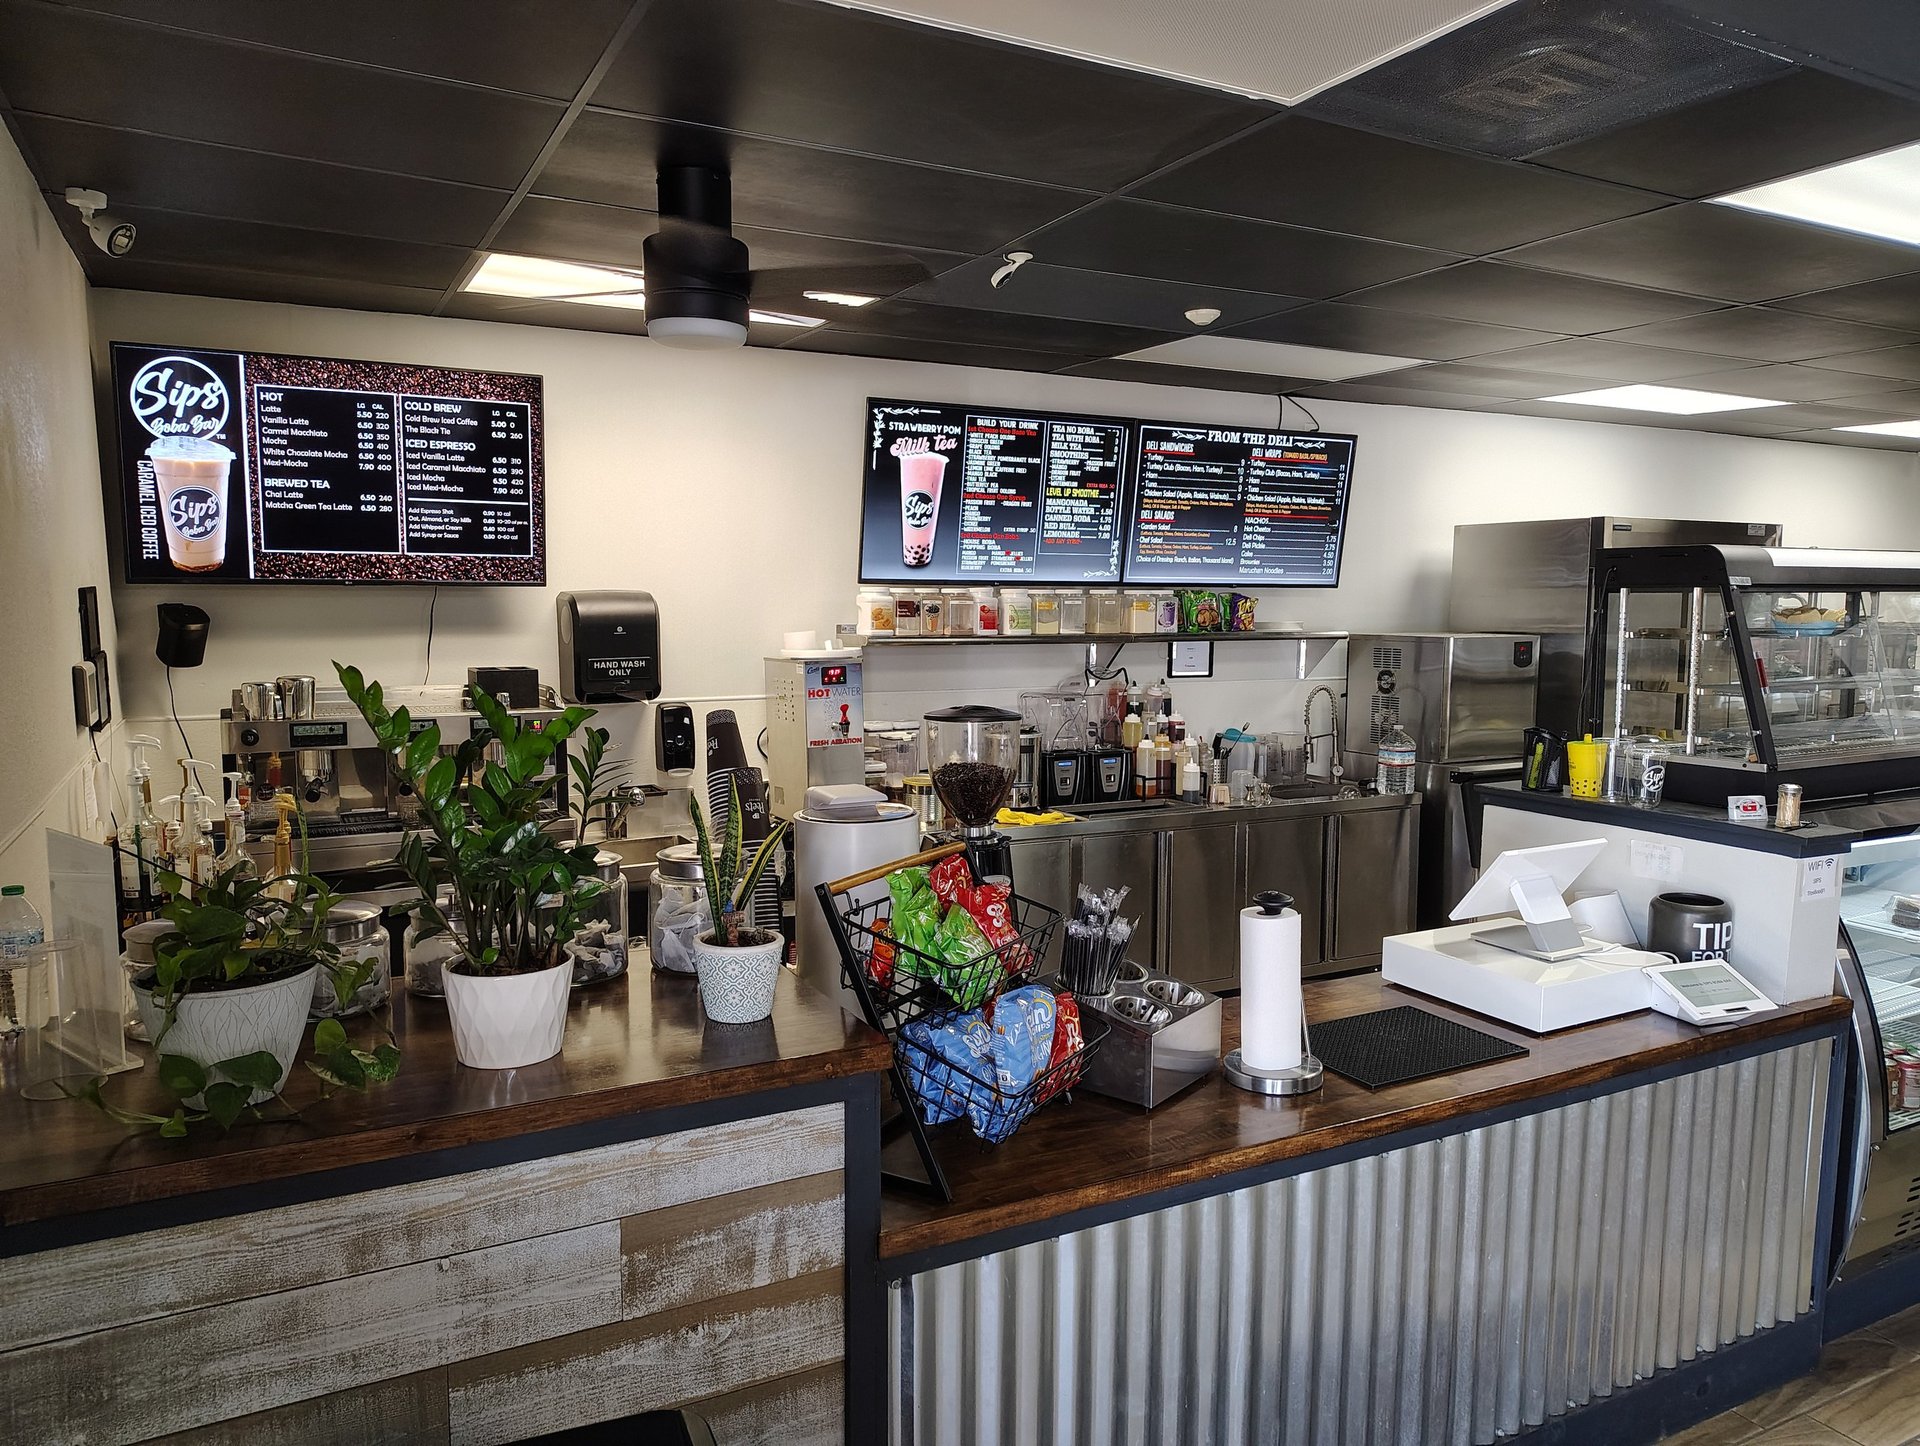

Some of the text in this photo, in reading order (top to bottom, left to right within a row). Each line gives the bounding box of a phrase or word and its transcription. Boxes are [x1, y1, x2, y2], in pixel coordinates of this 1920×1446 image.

[135, 367, 223, 418] Sips
[260, 391, 283, 401] HOT
[404, 401, 462, 413] COLD BREW
[151, 414, 220, 434] Boba Bar
[261, 416, 288, 424] Vanilla
[289, 418, 310, 426] Latte
[405, 414, 420, 422] Cold
[422, 415, 440, 424] Brew
[441, 416, 455, 424] Iced
[456, 418, 478, 426] Coffee
[977, 418, 1038, 430] BUILD YOUR DRINK
[262, 426, 290, 436] Carmel
[290, 428, 328, 438] Macchiato
[405, 425, 418, 433] The
[420, 426, 440, 435] Black
[440, 427, 450, 435] Tie
[888, 422, 962, 436] STRAWBERRY POM
[1066, 426, 1076, 434] NO
[1077, 426, 1094, 435] BOBA
[262, 436, 288, 446] Mocha
[1066, 434, 1084, 442] WITH
[1084, 436, 1100, 444] BOBA
[1208, 430, 1294, 448] FROM THE DELI
[405, 439, 476, 451] ICED ESPRESSO
[890, 434, 958, 457] Milk tea
[1146, 440, 1194, 452] DELI SANDWICHES
[263, 447, 286, 456] White
[286, 448, 322, 458] Chocolate
[324, 451, 348, 459] Mocha
[406, 451, 420, 460] Iced
[422, 452, 446, 460] Vanilla
[446, 454, 465, 462] Latte
[1050, 450, 1089, 460] SMOOTHIES
[1148, 453, 1164, 462] Turkey
[1252, 448, 1282, 458] DELI WRAPS
[263, 458, 308, 468] Mexi-Mocha
[406, 462, 420, 470] Iced
[422, 463, 451, 472] Caramel
[452, 464, 486, 474] Macchiato
[264, 478, 330, 489] BREWED TEA
[422, 474, 446, 482] Mocha
[407, 482, 422, 490] Iced
[422, 484, 464, 492] Mexi-Mocha
[265, 490, 282, 498] Chai
[284, 491, 304, 499] Latte
[1046, 488, 1062, 496] LEVEL
[1064, 488, 1072, 497] UP
[1072, 488, 1100, 498] SMOOTHIE
[265, 500, 294, 509] Matcha
[294, 502, 316, 510] Green
[318, 502, 332, 510] Tea
[333, 503, 353, 511] Latte
[905, 494, 934, 516] Sips
[1046, 498, 1088, 506] MANGONADA
[137, 460, 160, 560] CARAMEL ICED COFFEE
[170, 495, 218, 526] Sips
[1140, 510, 1174, 520] DELI SALADS
[1044, 514, 1072, 522] CANNED
[1043, 530, 1080, 538] LEMONADE
[594, 660, 646, 670] HAND WASH
[608, 668, 632, 676] ONLY
[808, 686, 862, 698] HOT WATER
[1643, 770, 1664, 787] Sips
[1692, 921, 1732, 950] TIP
